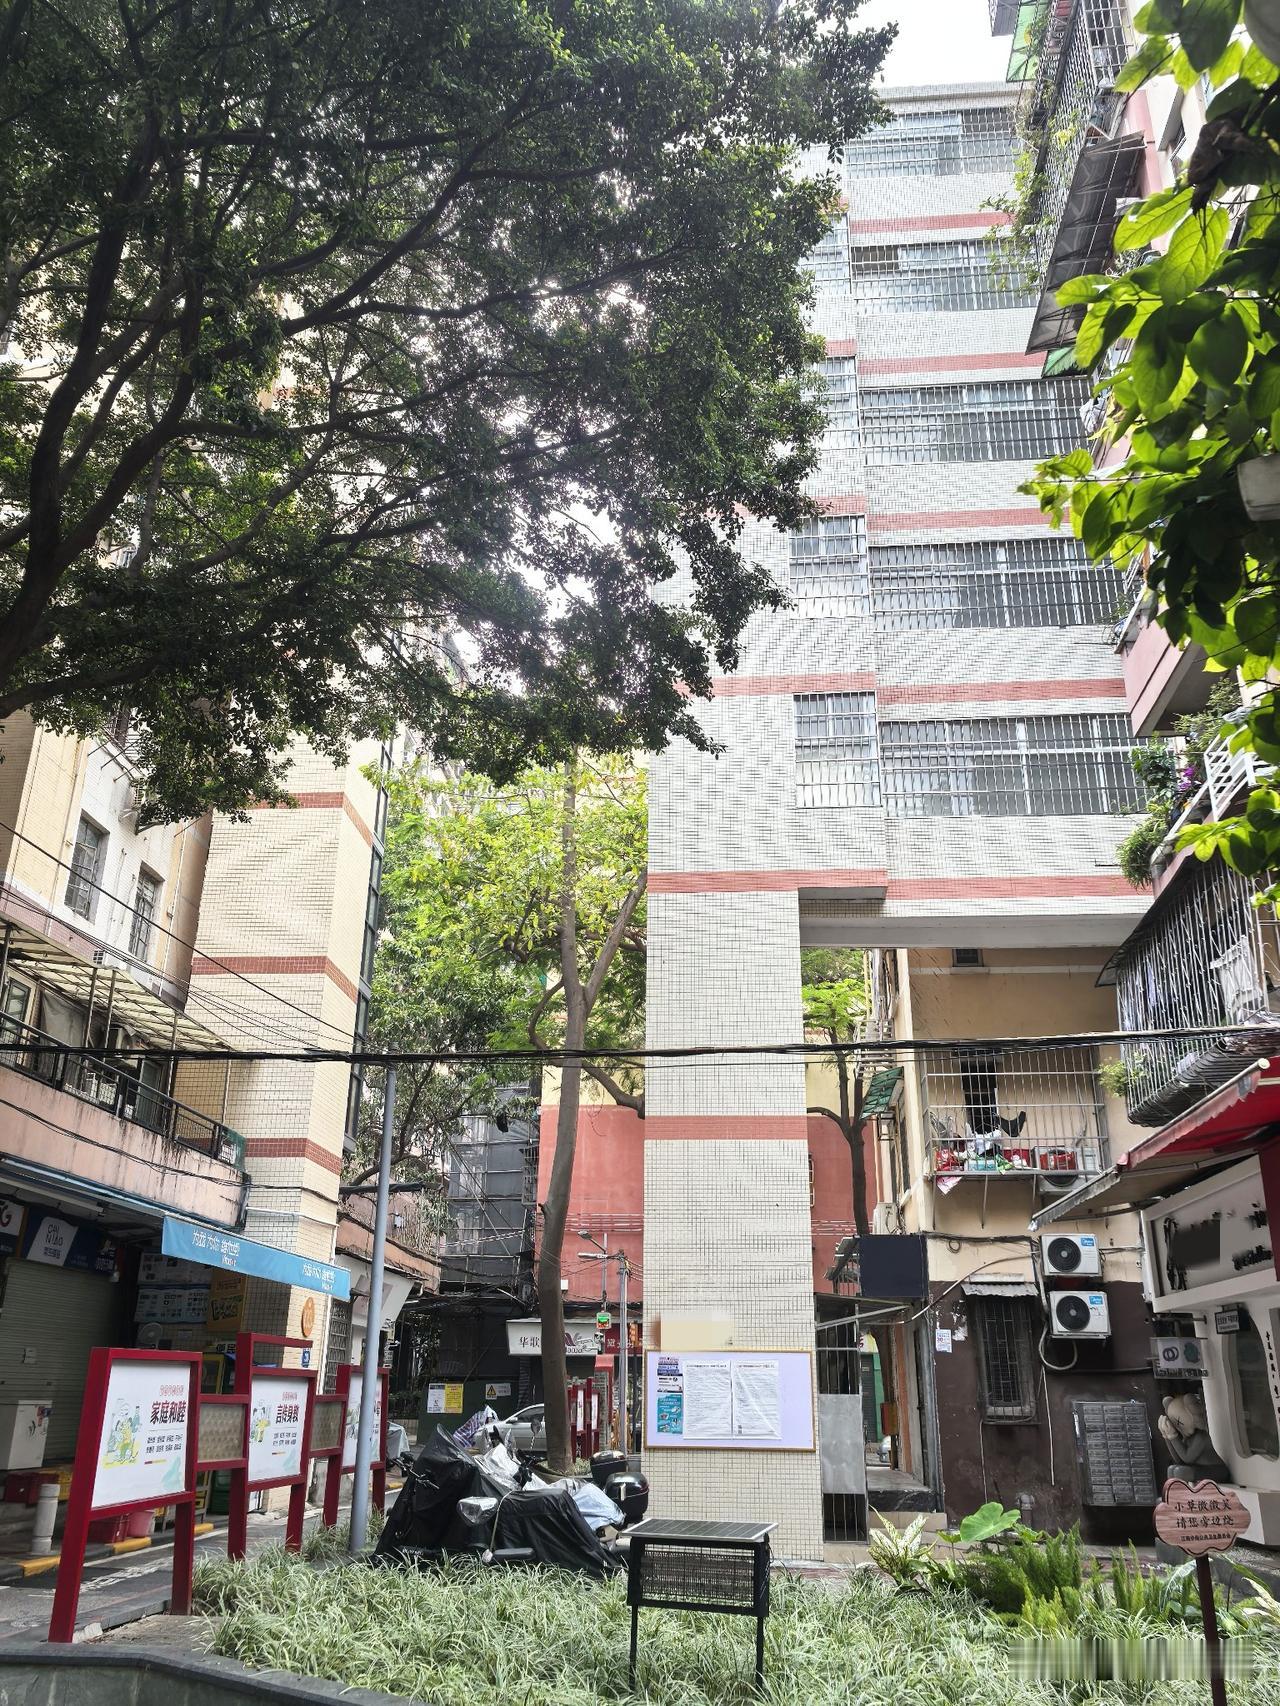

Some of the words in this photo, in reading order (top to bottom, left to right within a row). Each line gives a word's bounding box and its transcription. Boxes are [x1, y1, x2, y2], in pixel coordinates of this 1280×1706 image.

[150, 1400, 186, 1425] 家庭和睦
[1174, 1498, 1232, 1512] 小草微微笑
